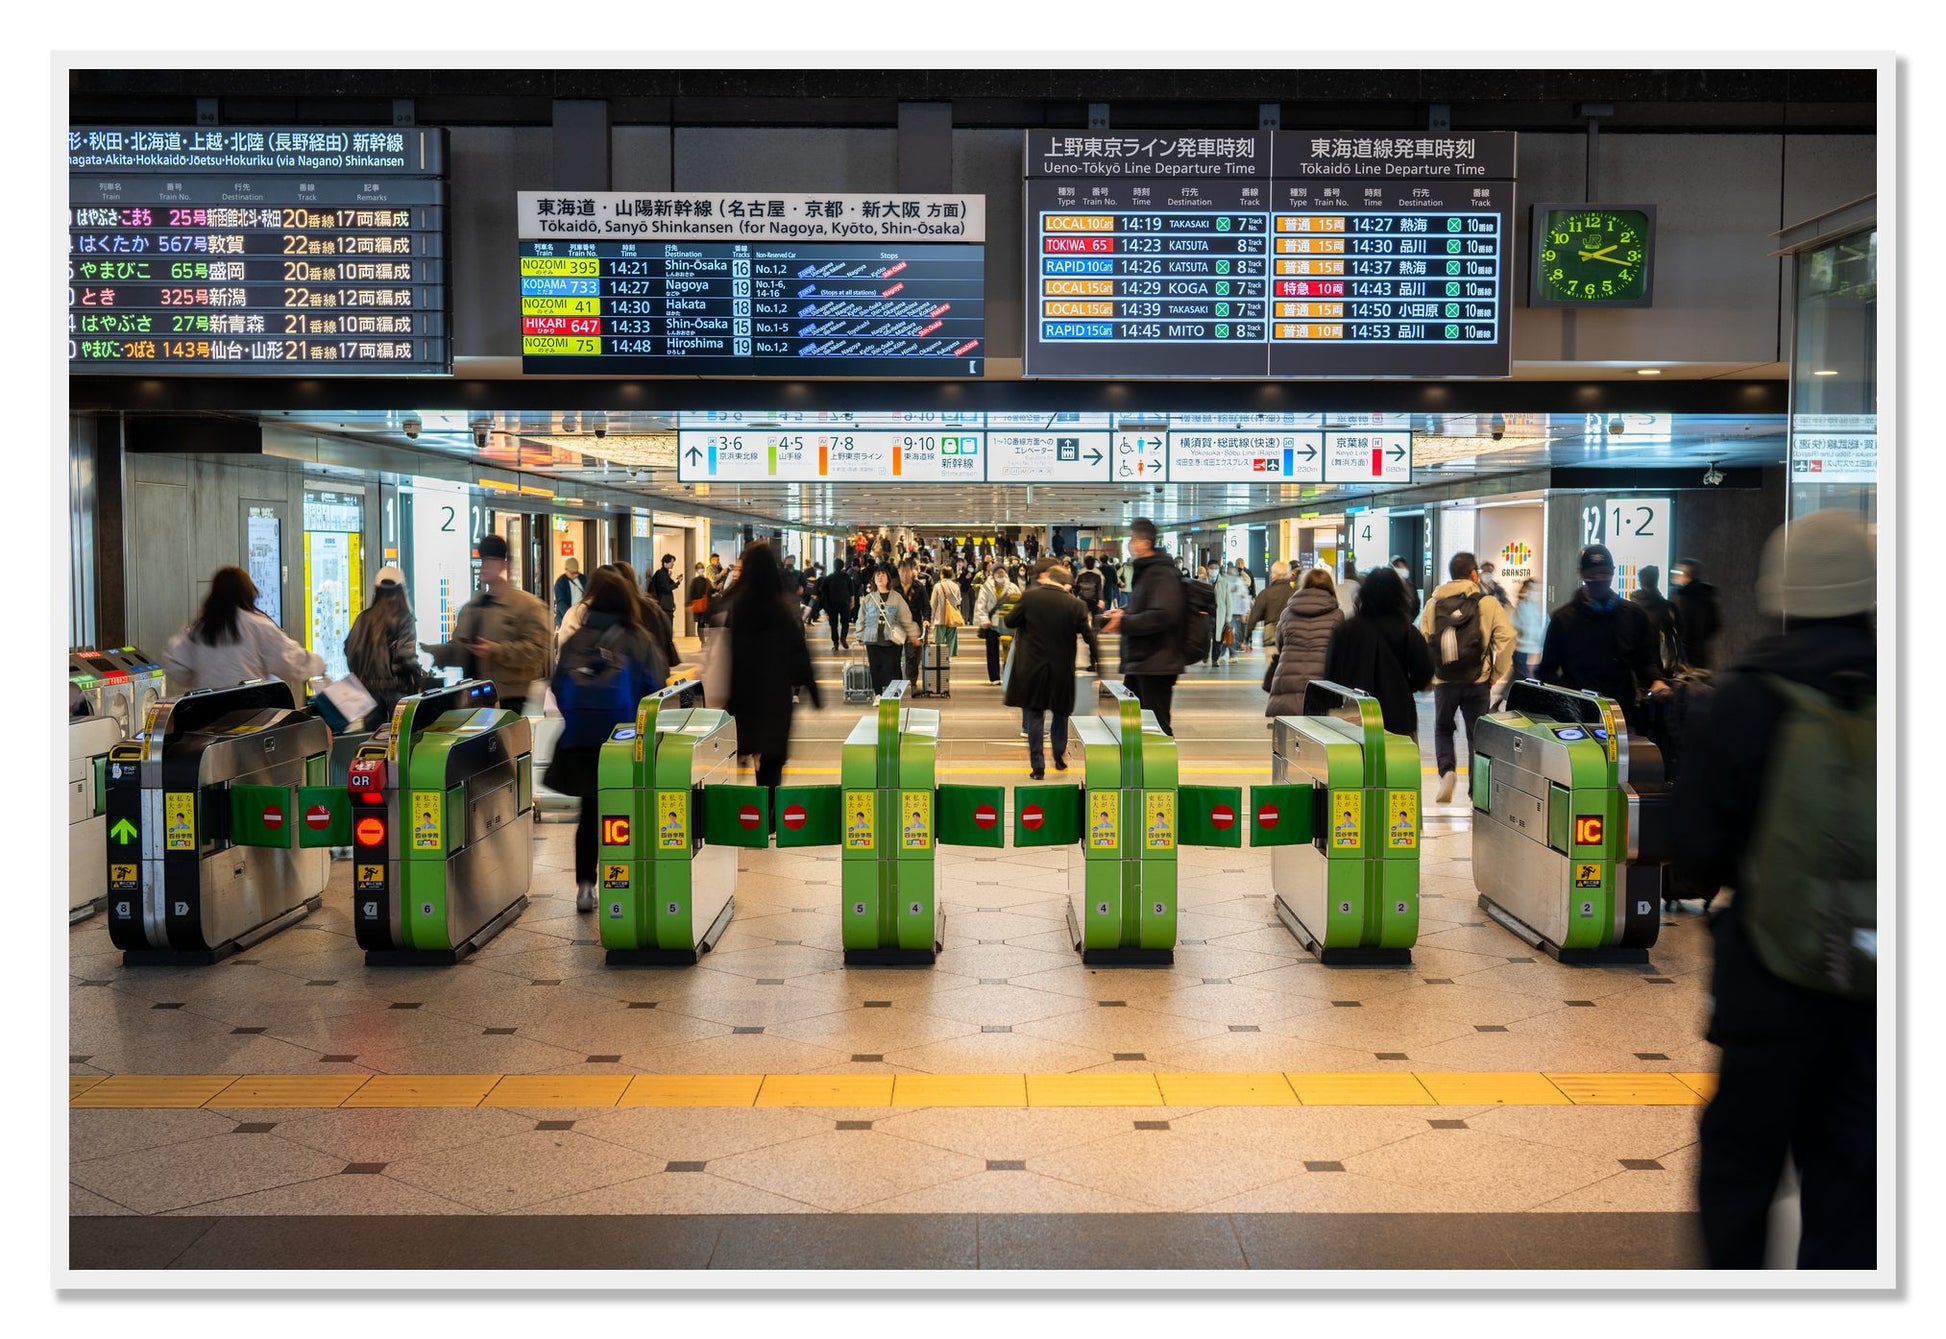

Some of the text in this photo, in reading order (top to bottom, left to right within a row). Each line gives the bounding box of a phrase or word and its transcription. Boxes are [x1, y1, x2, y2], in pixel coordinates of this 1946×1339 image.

[1044, 136, 1256, 159] 上野東京ライン発車時刻
[1310, 138, 1476, 160] 東海道線発車時刻
[276, 155, 295, 168] (via
[299, 155, 343, 168] Nagano)
[346, 155, 405, 167] Shinkansen
[1044, 161, 1256, 176] Ueno-Tōkyō Line Departure Time
[1300, 162, 1486, 177] Tōkaidō Line Departure Time
[1167, 198, 1212, 206] Destination
[169, 209, 207, 227] 25号
[283, 208, 335, 229] 20番線
[336, 210, 410, 228] 17両編成
[1045, 217, 1086, 230] LOCAL
[1121, 217, 1162, 231] 14:19
[1169, 220, 1210, 228] TAKASAKI
[1284, 217, 1311, 232] 普通
[1352, 218, 1393, 231] 14:27
[1400, 217, 1428, 232] 熱海
[1584, 217, 1600, 228] 12
[539, 219, 966, 237] Tōkaidō, Sanyō Shinkansen (for Nagoya, Kyōto, Shin-Ōsaka)
[79, 234, 245, 254] はくたか 567号 敦賀
[1046, 238, 1209, 252] TOKIWA 65 14:23 KATSUTA
[1352, 239, 1427, 253] 14:30 品川
[880, 252, 899, 260] Stops
[1546, 250, 1638, 262] 9 3
[80, 261, 245, 281] やまびこ 65号 盛岡
[522, 259, 567, 270] NOZOMI
[570, 261, 597, 274] 395
[610, 261, 649, 275] 14:21
[733, 261, 749, 275] 16
[1046, 259, 1162, 274] RAPID 14:26
[523, 279, 567, 289] KODAMA
[570, 281, 598, 294] 733
[610, 281, 650, 295] 14:27
[666, 279, 709, 292] Nagoya
[756, 289, 780, 297] 14-16
[1045, 281, 1208, 295] LOCAL 14:29 KOGA
[1283, 281, 1392, 296] 特急 14:43
[1584, 284, 1596, 295] 6
[82, 287, 337, 307] とき 325号 新潟 22番線
[524, 298, 706, 314] NOZOMI 41 14:30 Hakata
[1121, 302, 1161, 317] 14:39
[1351, 303, 1439, 318] 14:50 小田原
[82, 314, 412, 334] はやぶさ 27号 新青森 21番線 10両編成
[526, 318, 651, 334] HIKARI 647 14:33
[1120, 324, 1205, 338] 14:45 MITO
[1350, 325, 1391, 339] 14:53
[163, 341, 210, 359] 143号
[210, 340, 283, 360] 仙台・山形
[339, 342, 412, 359] 17両編成
[524, 337, 724, 353] NOZOMI 75 14:48 Hiroshima
[1336, 437, 1369, 448] 京葉線
[719, 452, 759, 460] 京浜東北線
[778, 452, 802, 460] 山手線
[830, 452, 883, 460] 上野東京ライン
[904, 452, 935, 460] 東海道線
[941, 458, 974, 468] 新幹線
[386, 498, 394, 542] 1
[441, 506, 456, 532] 2
[472, 506, 481, 544] 2
[1362, 524, 1372, 542] 4
[1424, 518, 1431, 548] 3
[1230, 535, 1238, 548] 6
[1502, 568, 1531, 577] GRANSTA
[352, 775, 370, 787] QR
[604, 820, 629, 843] IC
[1577, 820, 1602, 842] IC
[120, 904, 127, 913] 8
[178, 904, 184, 913] 7
[368, 904, 374, 913] 7
[424, 905, 430, 914] 6
[670, 904, 676, 912] 5
[1100, 904, 1106, 912] 4
[1398, 904, 1404, 912] 2
[1640, 904, 1646, 912] 1
